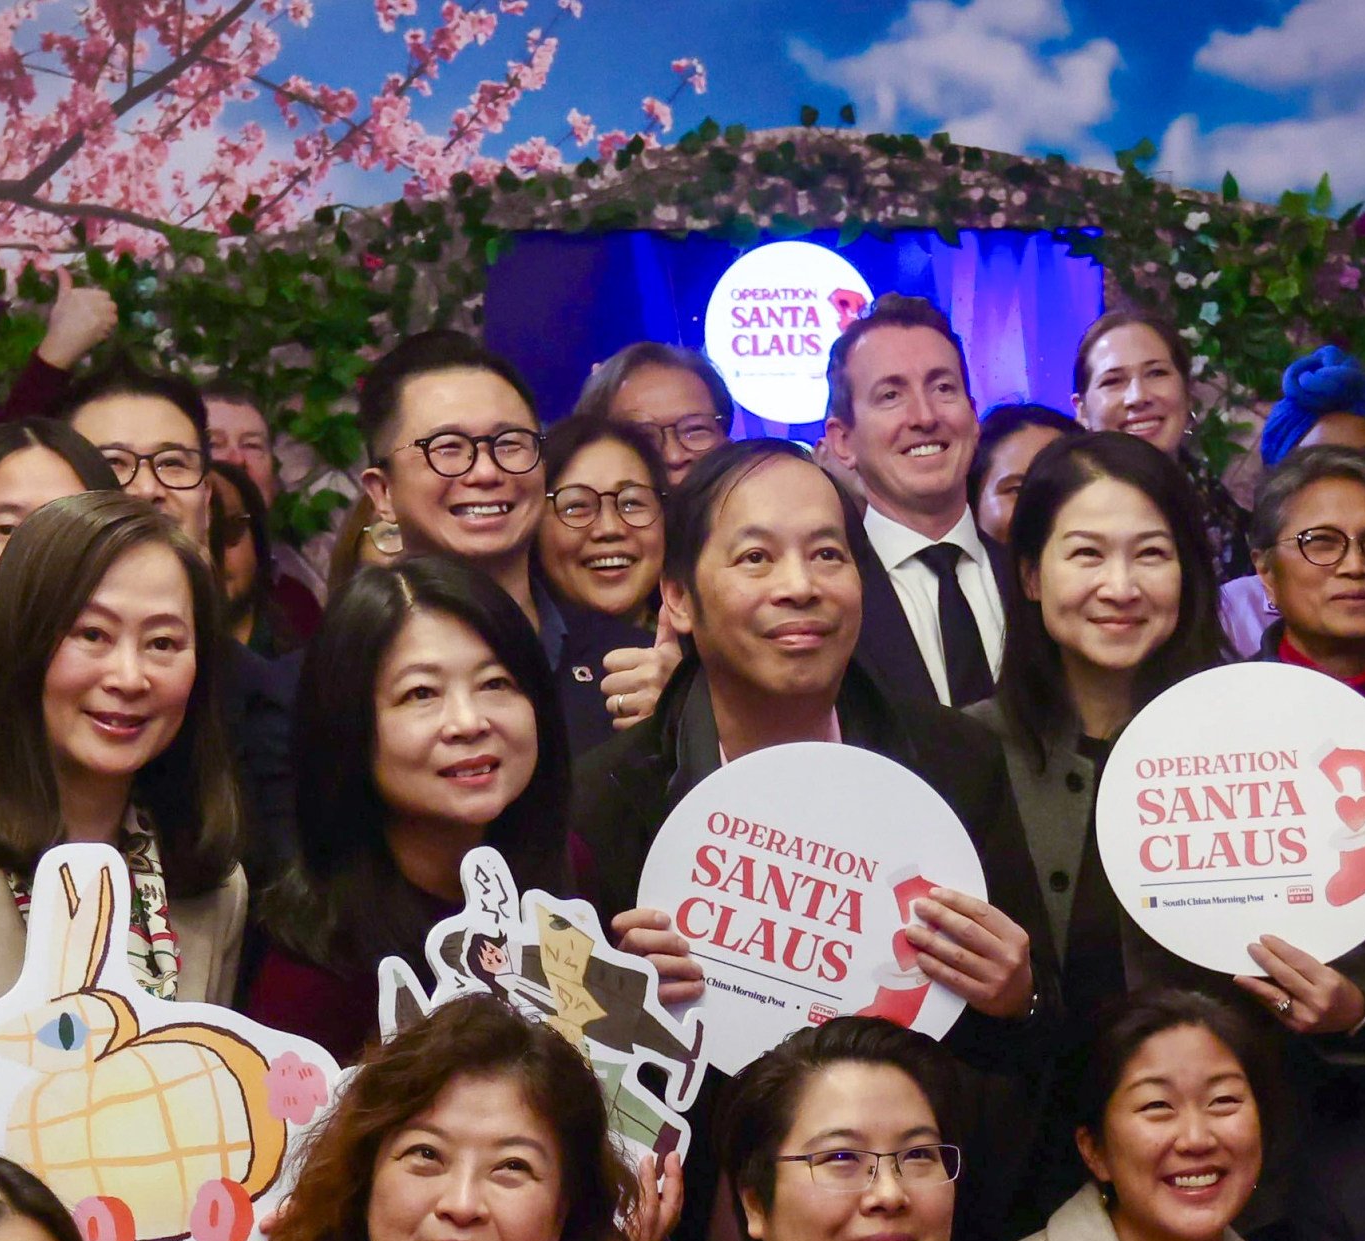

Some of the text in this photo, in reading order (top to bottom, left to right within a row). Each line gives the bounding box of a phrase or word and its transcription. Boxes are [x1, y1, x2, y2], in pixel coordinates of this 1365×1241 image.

[731, 288, 818, 301] OPERATION
[731, 306, 821, 328] SANTA
[731, 334, 822, 356] CLAUS
[1135, 749, 1299, 780] OPERATION
[1136, 780, 1307, 826] SANTA
[707, 811, 879, 883] OPERATION
[1139, 826, 1308, 873] CLAUS
[691, 844, 864, 934] SANTA
[1162, 894, 1264, 908] South China Morning Post
[676, 897, 853, 983] CLAUS
[706, 976, 731, 991] China
[733, 984, 767, 1004] Morning
[767, 995, 786, 1008] Post
